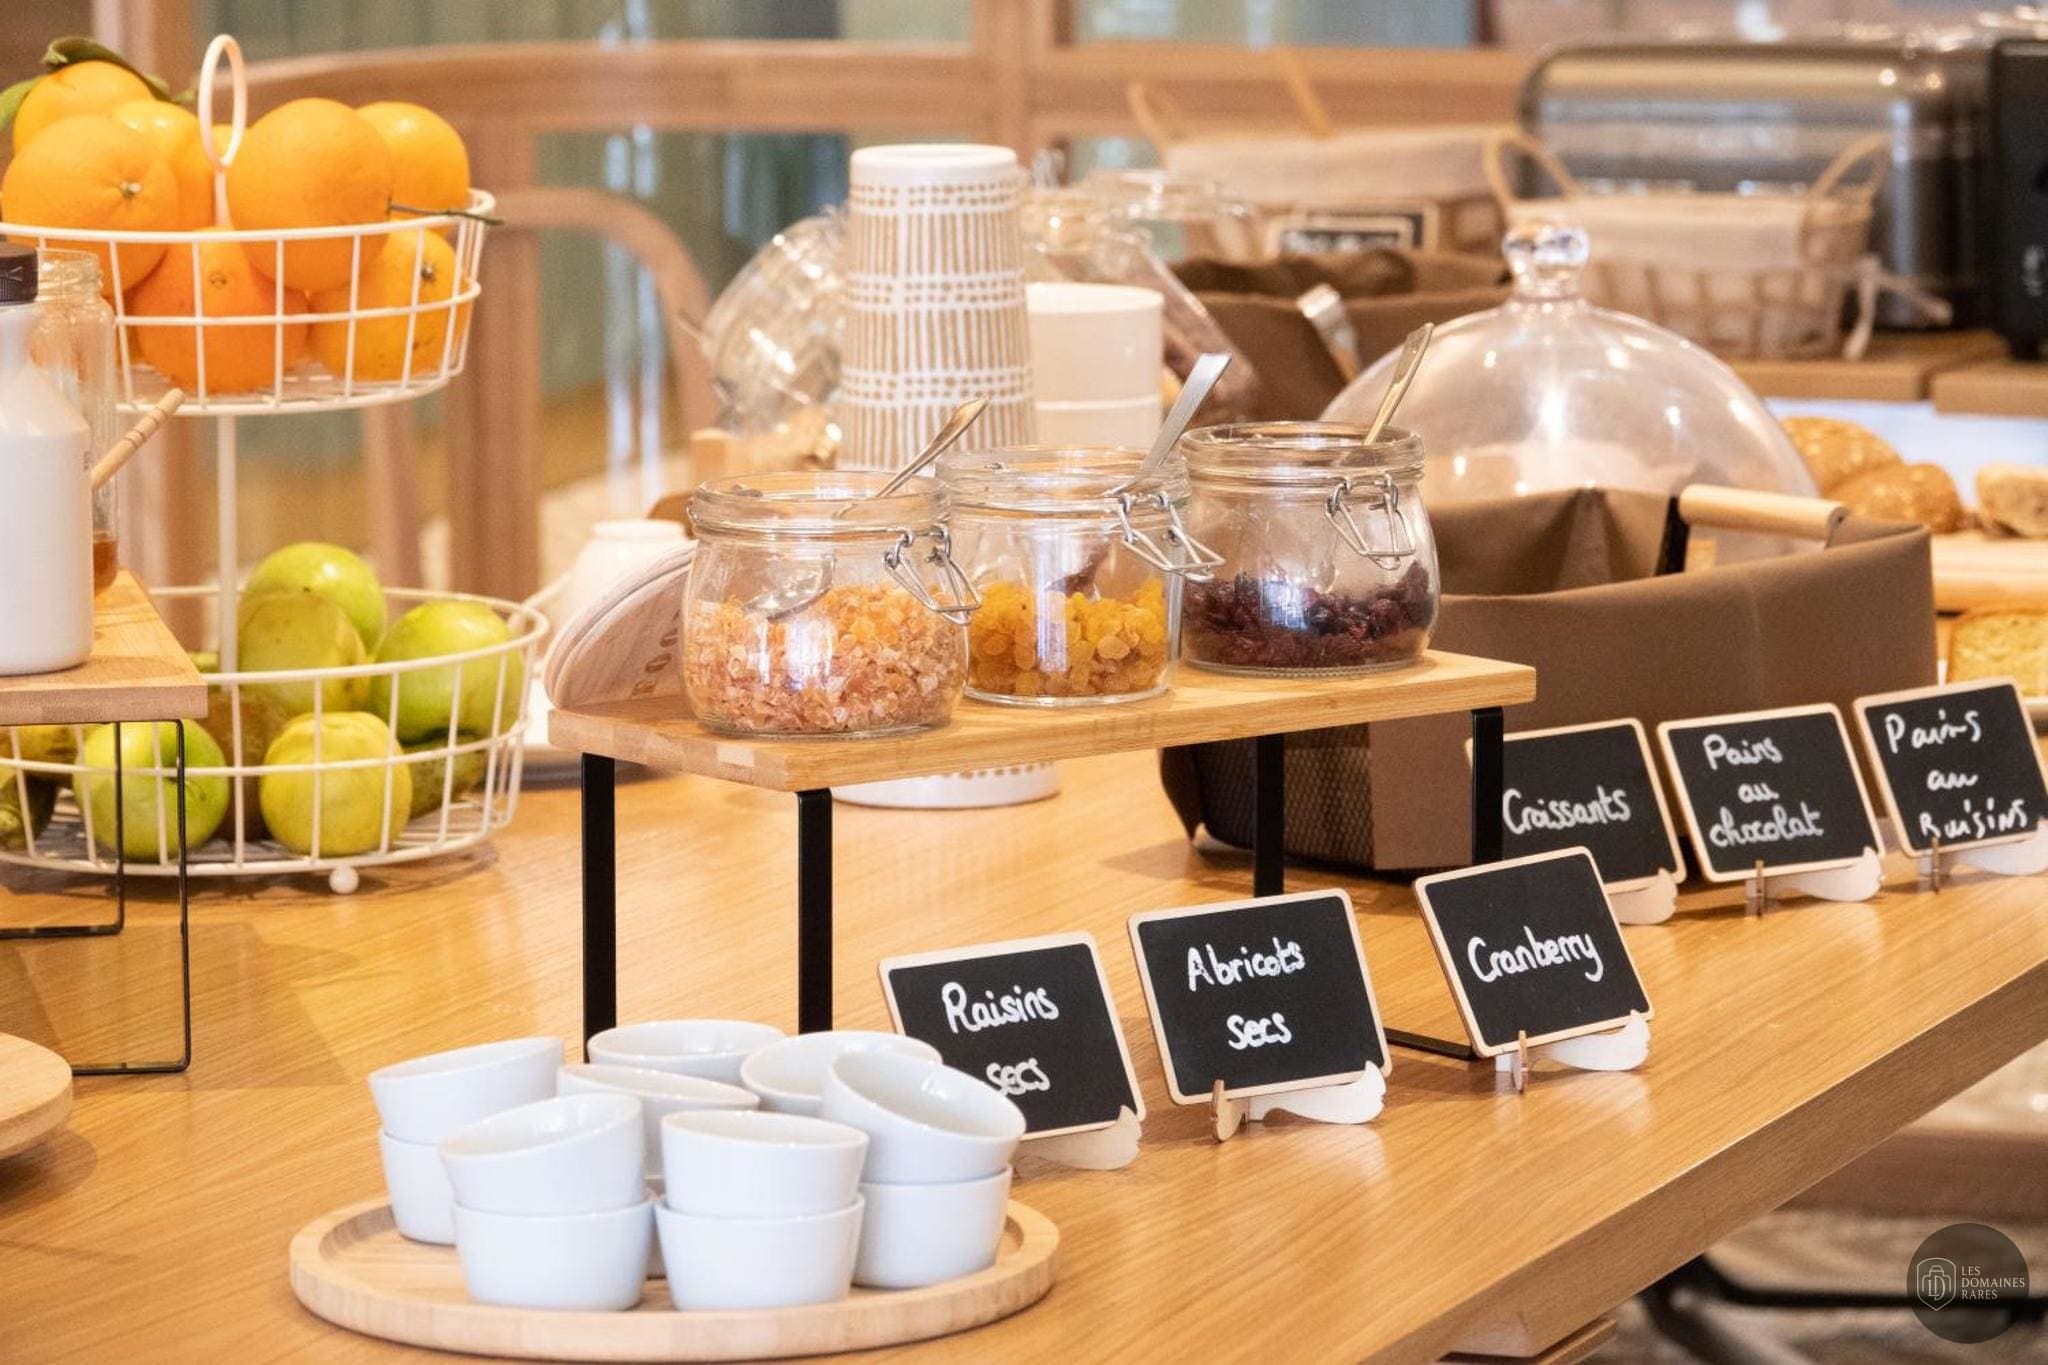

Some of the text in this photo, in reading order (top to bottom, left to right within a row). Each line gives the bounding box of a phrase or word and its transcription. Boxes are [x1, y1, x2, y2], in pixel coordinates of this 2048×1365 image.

[1702, 733, 1783, 771] Pains
[1884, 708, 1982, 754] Pains
[1737, 782, 1779, 805] au
[1926, 769, 1979, 792] au
[1502, 785, 1632, 835] Croissants
[1708, 800, 1825, 848] chocolat
[1187, 936, 1306, 992] Abricots
[1467, 924, 1605, 984] Cranberry
[941, 981, 1060, 1034] Raisins
